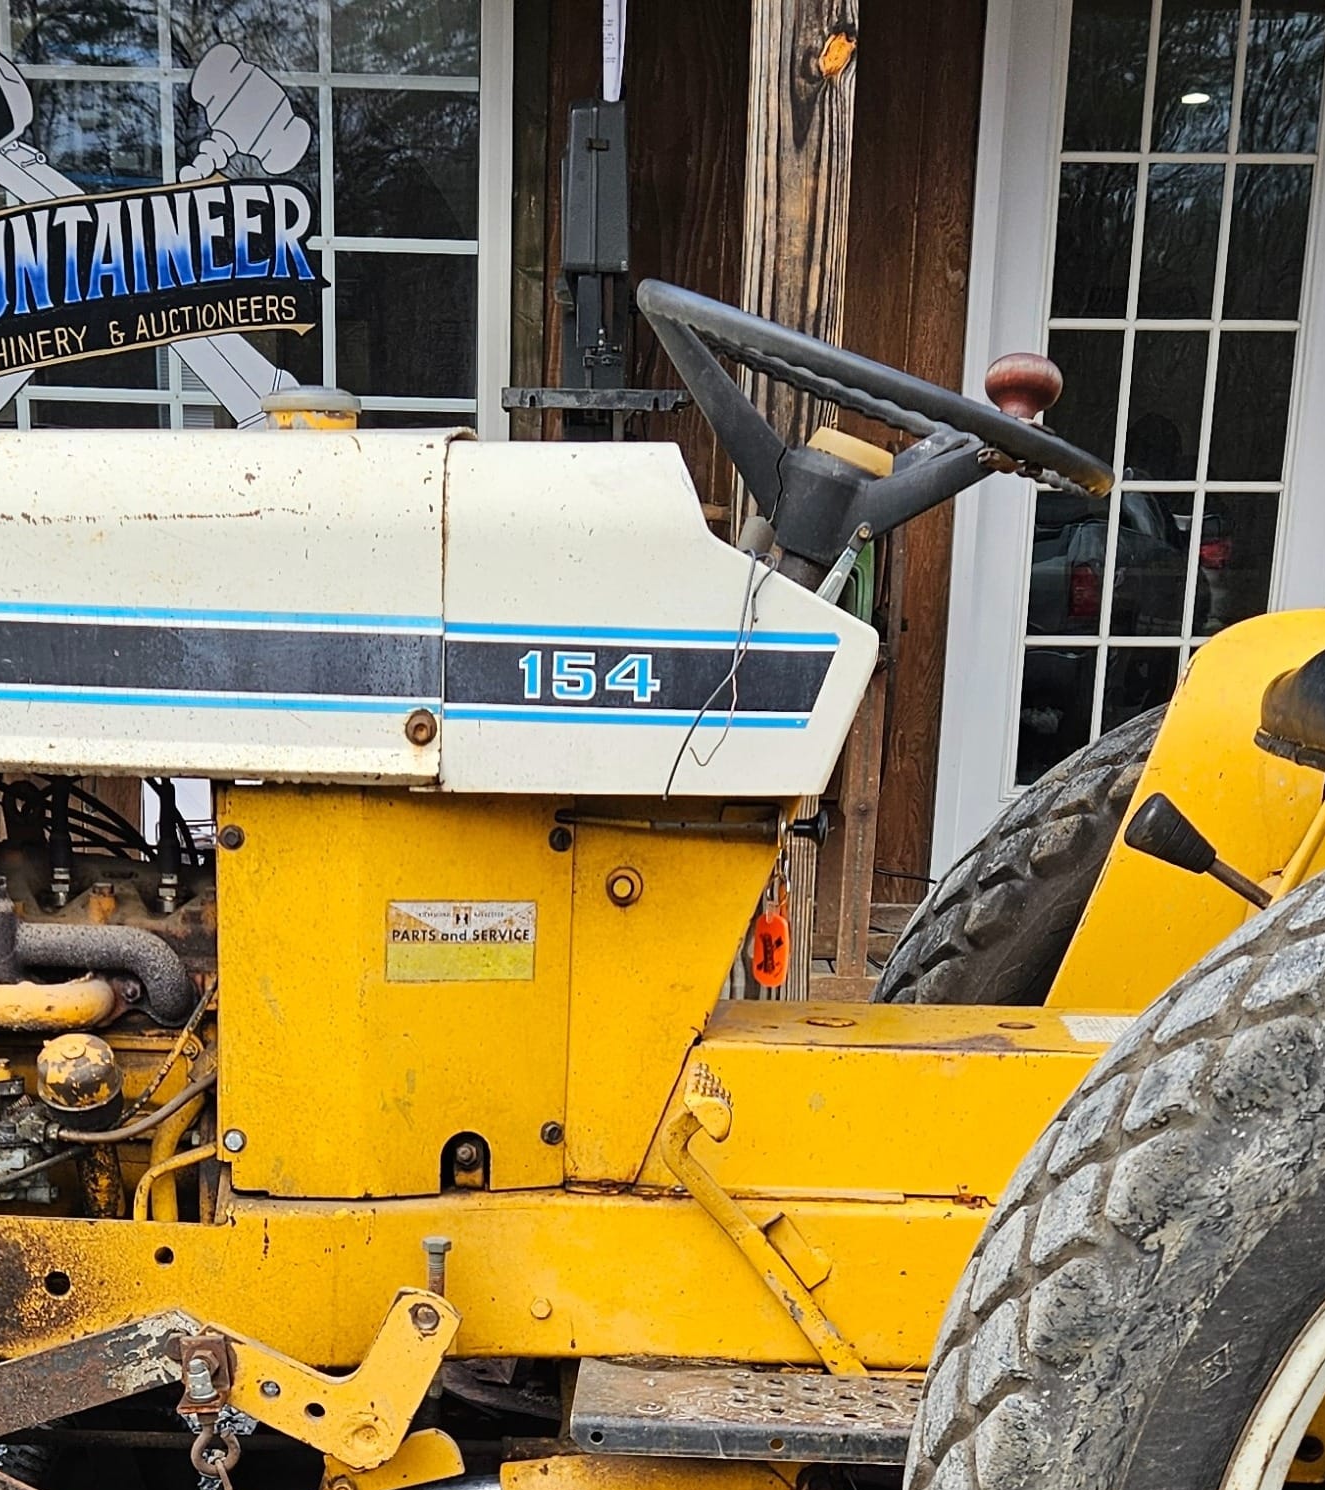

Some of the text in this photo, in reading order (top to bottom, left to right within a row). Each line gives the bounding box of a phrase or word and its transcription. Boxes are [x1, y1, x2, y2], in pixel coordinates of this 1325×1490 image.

[109, 321, 125, 345] &
[135, 296, 297, 340] AUCTIONEERS
[518, 650, 661, 703] 154
[392, 928, 530, 942] PARTS and SERVICE
